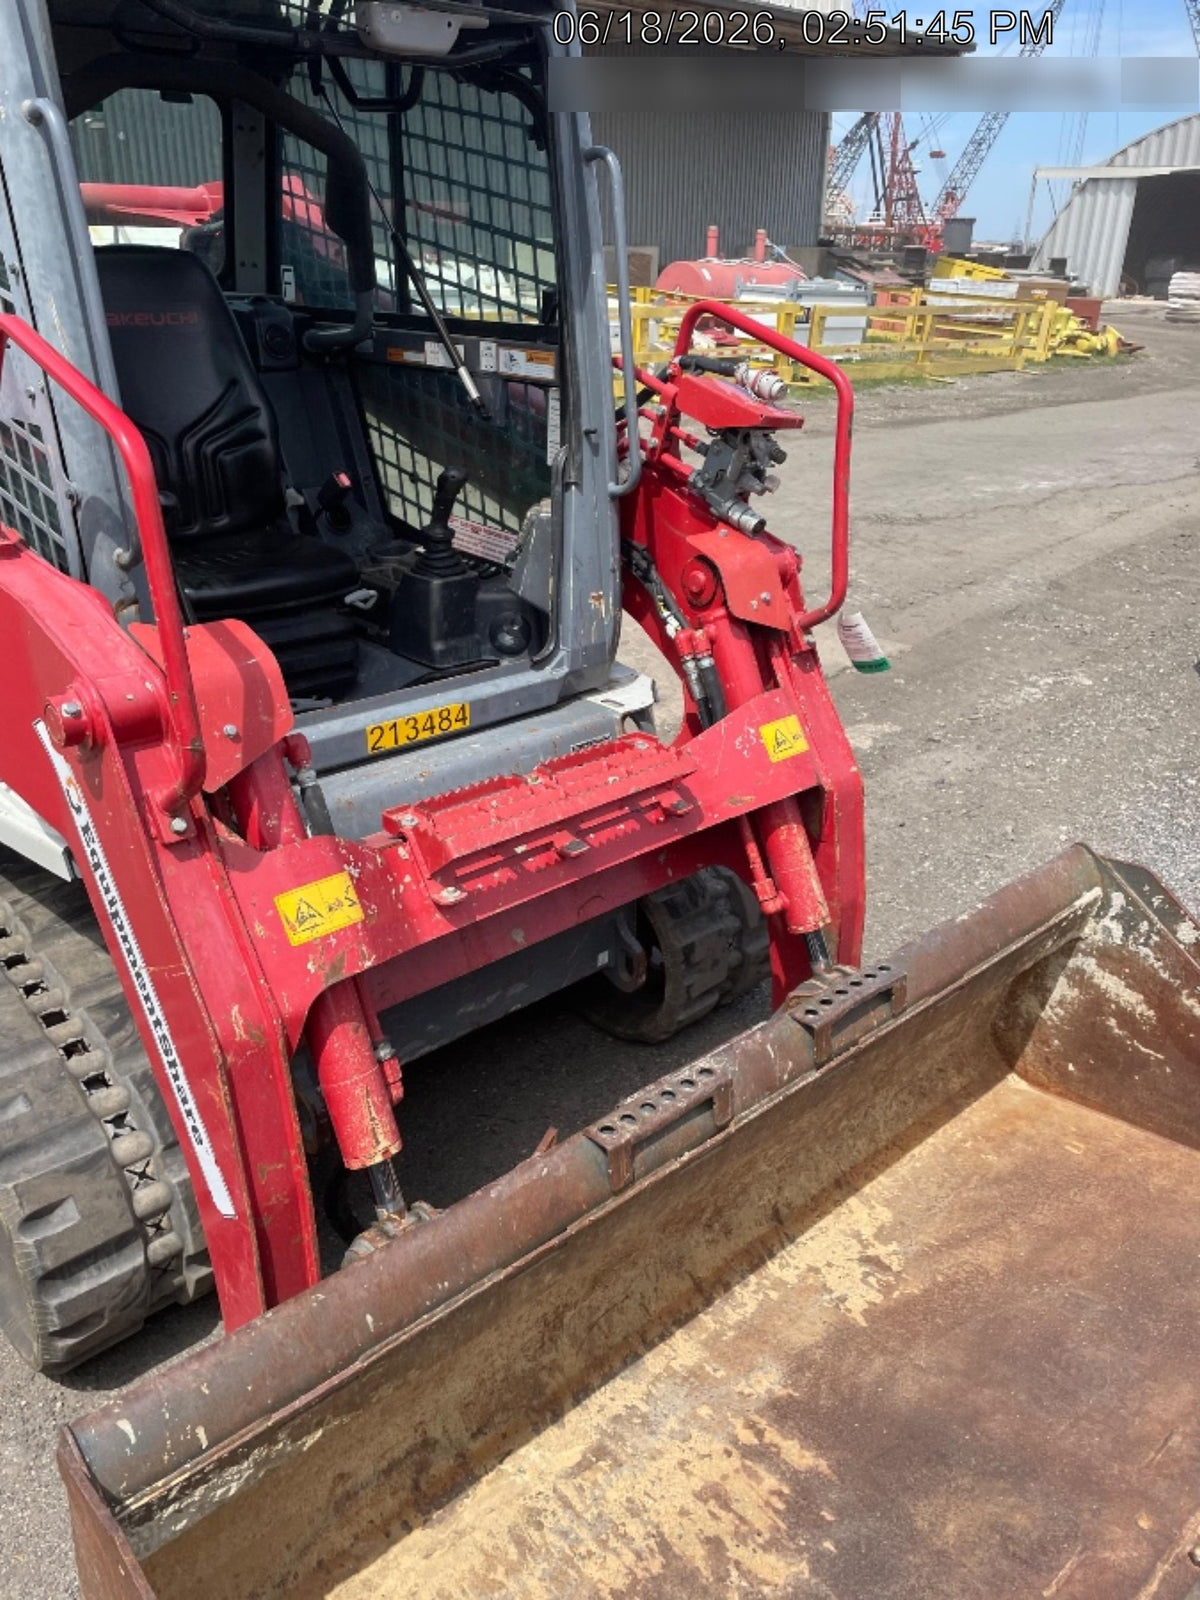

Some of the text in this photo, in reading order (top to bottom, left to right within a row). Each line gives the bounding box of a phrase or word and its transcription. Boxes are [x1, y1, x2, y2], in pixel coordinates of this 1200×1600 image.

[105, 312, 199, 327] AKEUCHI
[370, 703, 468, 751] 213484
[81, 821, 203, 1146] EquipmentShare
